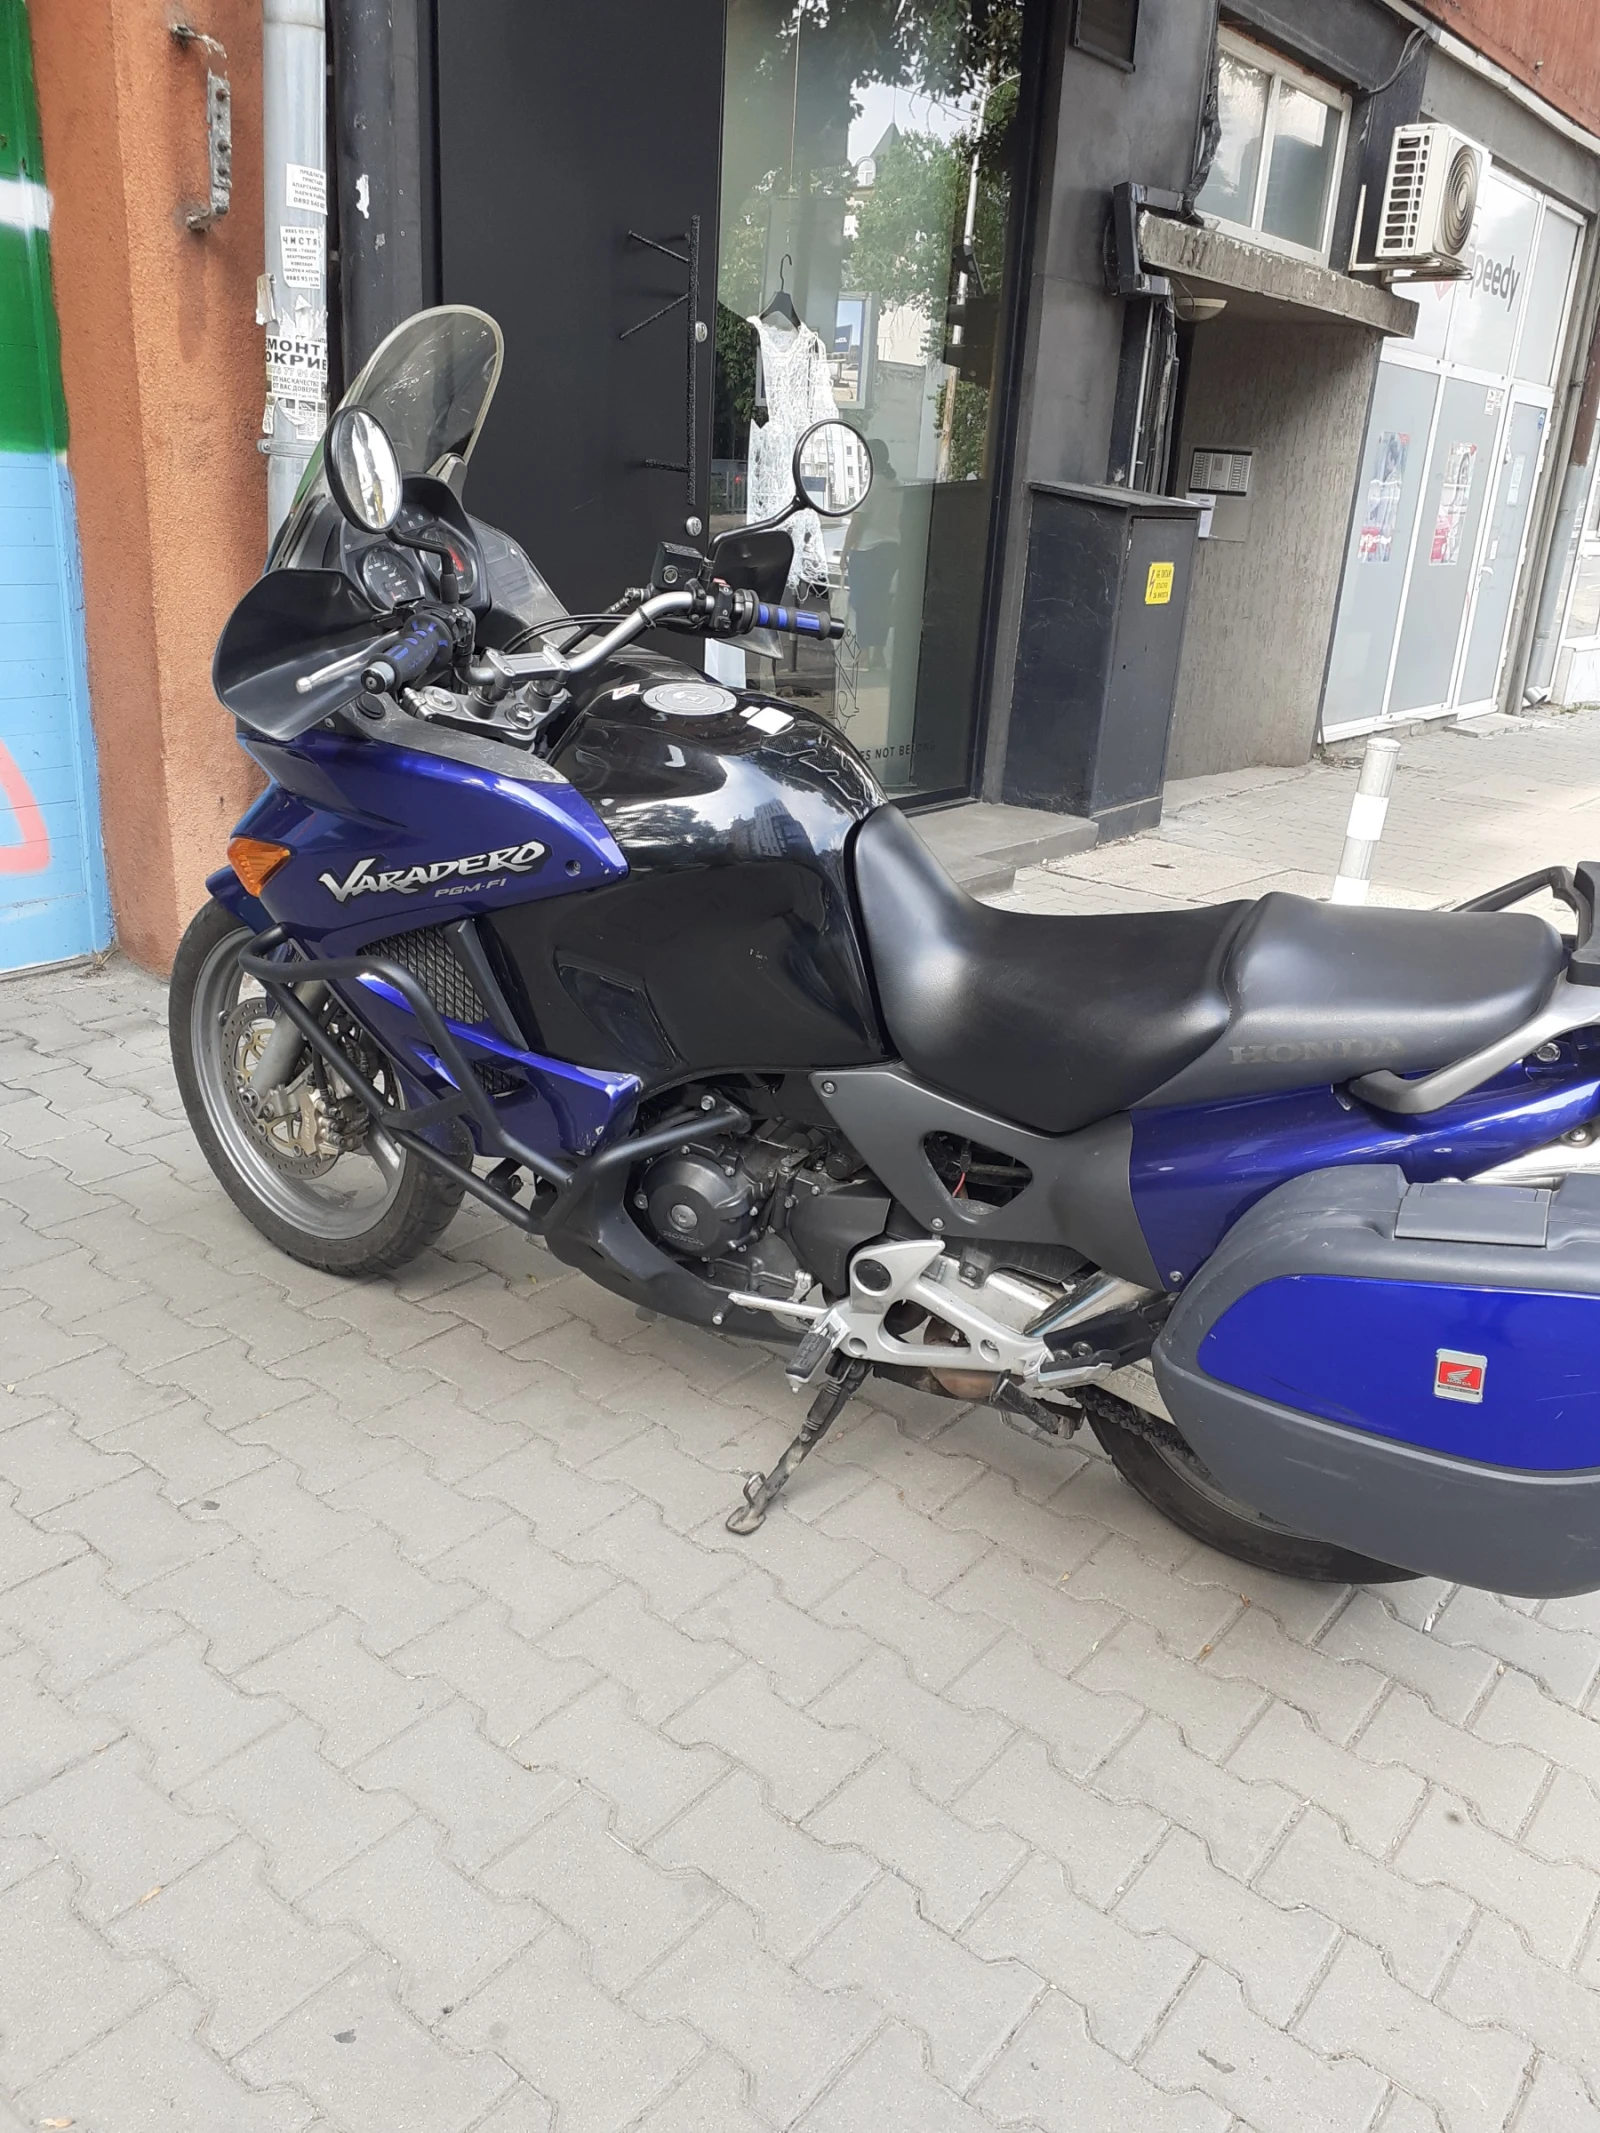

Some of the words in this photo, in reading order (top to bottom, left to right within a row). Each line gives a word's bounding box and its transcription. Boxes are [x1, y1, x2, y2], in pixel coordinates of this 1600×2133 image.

[282, 236, 318, 246] ЧИСТЯ
[1464, 254, 1521, 312] peedy
[264, 337, 320, 356] МОНТ
[279, 376, 291, 384] НАС
[291, 378, 319, 387] КАЧЕСТВО
[280, 383, 292, 391] ВАС
[292, 385, 319, 394] ДОВЕРИЕ
[875, 746, 895, 759] NOT
[319, 841, 546, 902] VARADERO
[434, 878, 507, 898] PGM-FI
[1228, 1039, 1402, 1065] HONDA
[662, 1229, 705, 1246] HONDA
